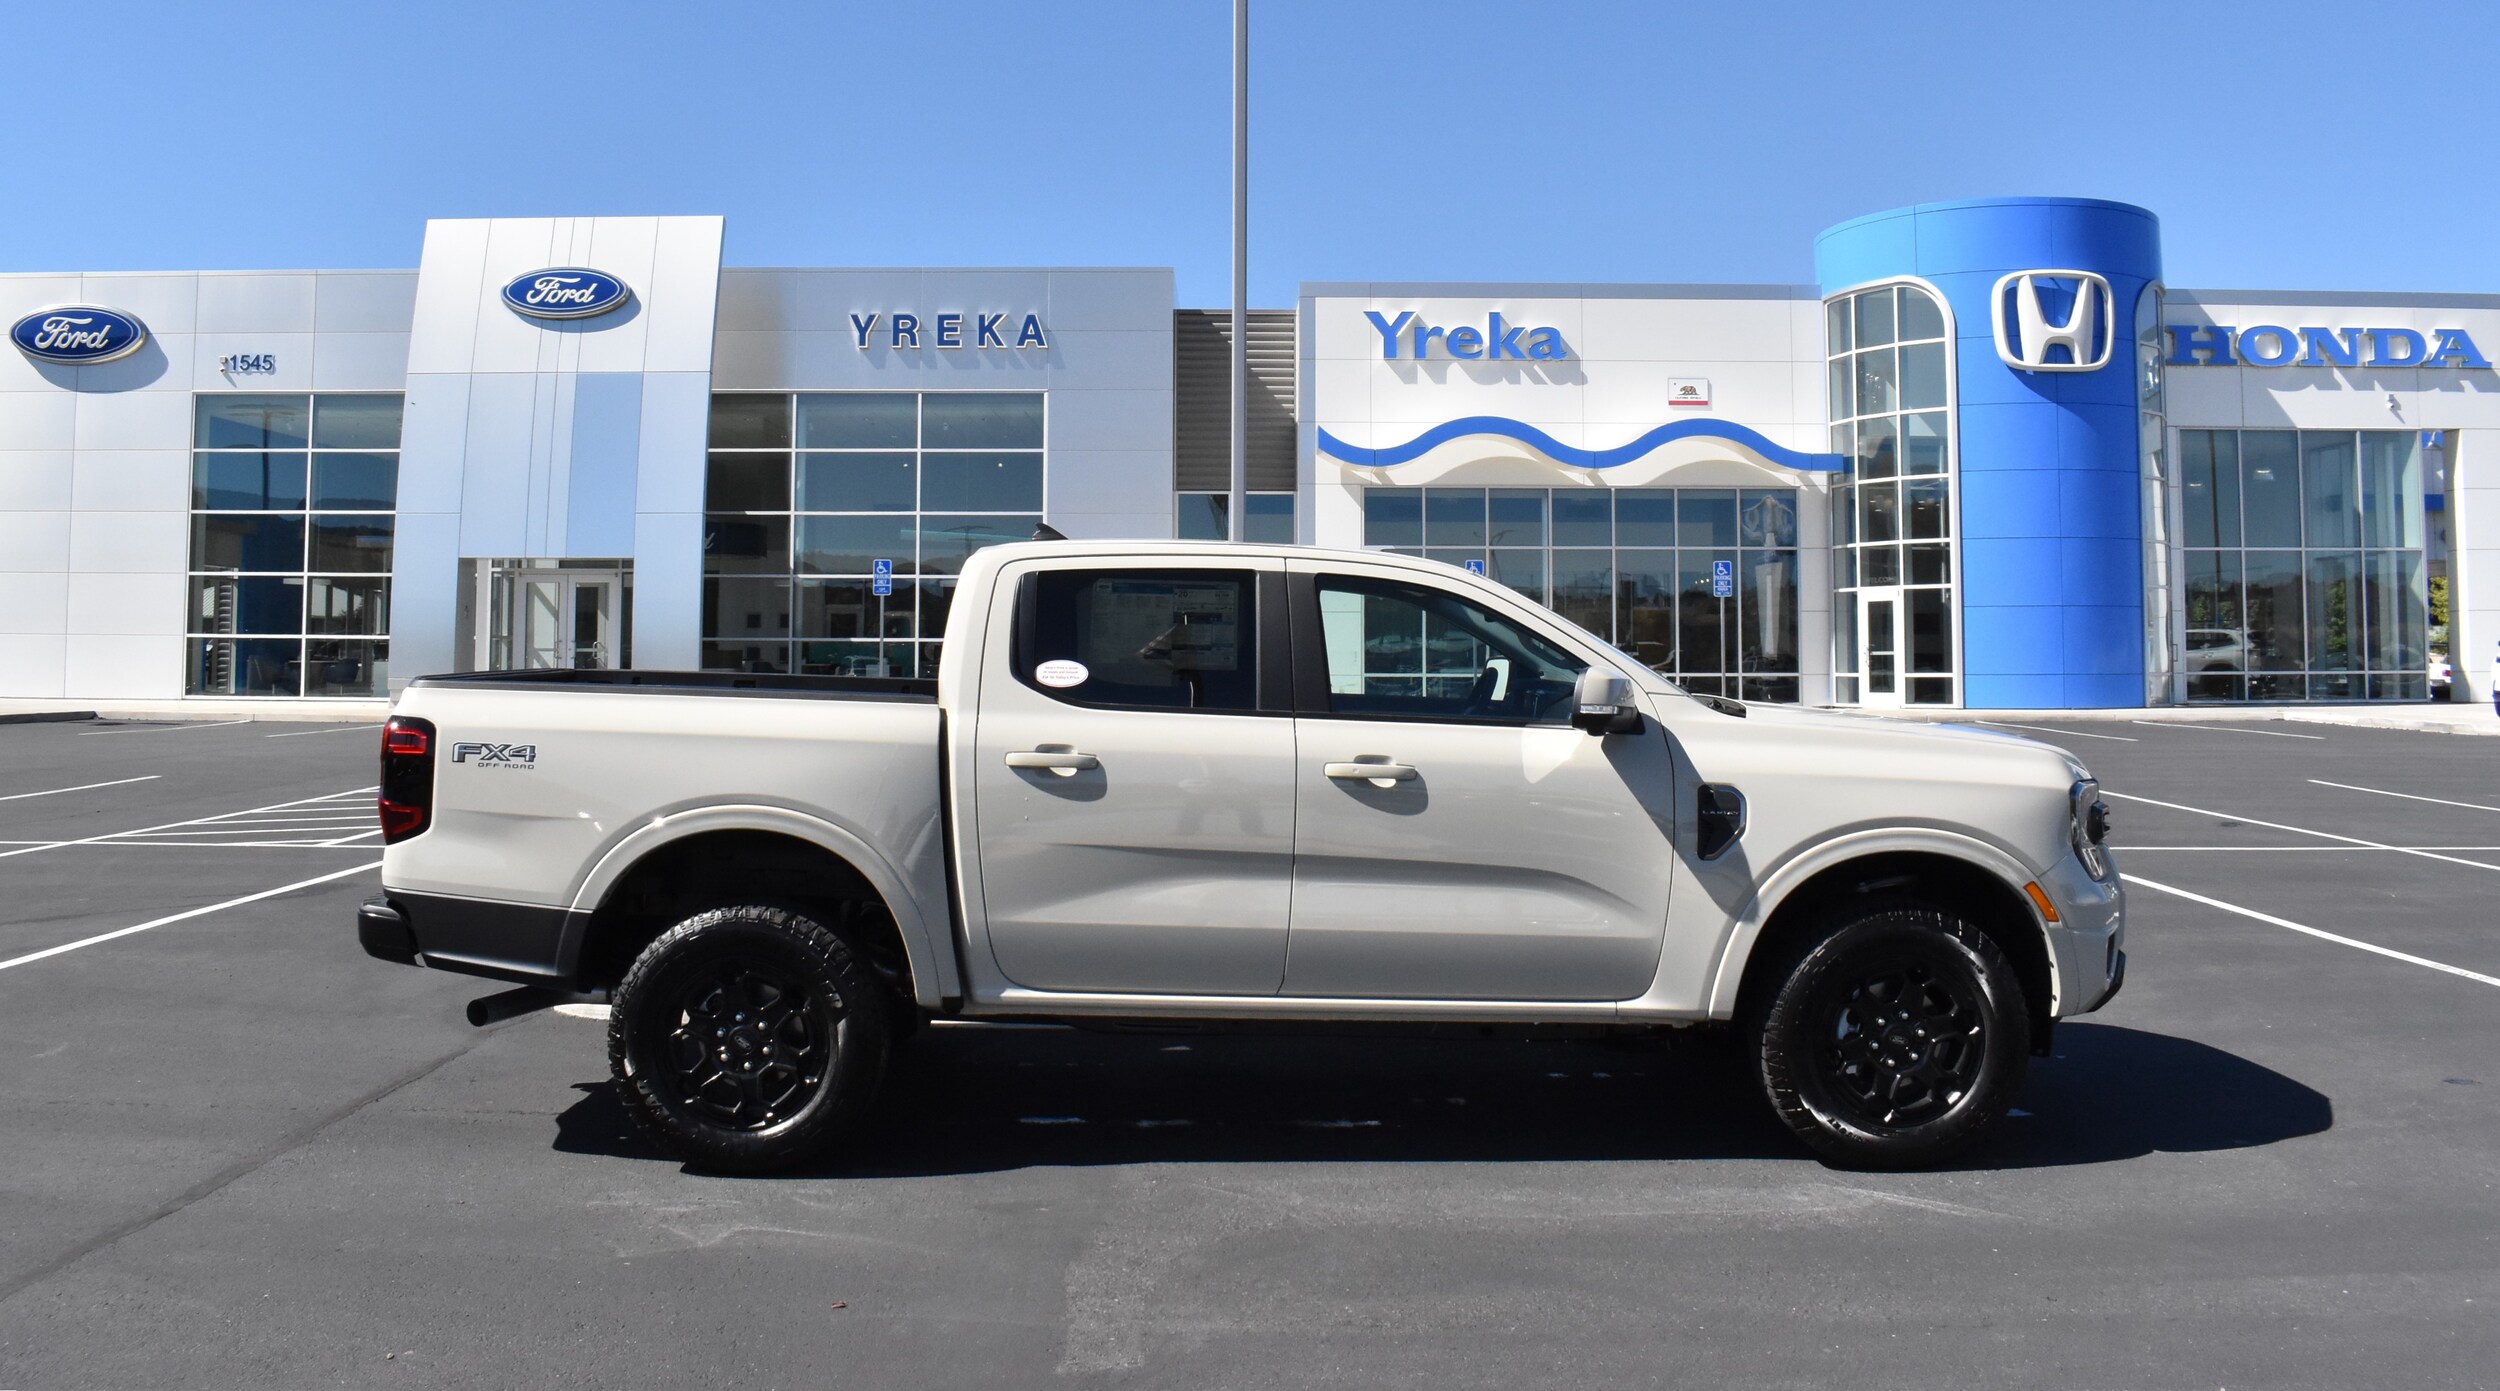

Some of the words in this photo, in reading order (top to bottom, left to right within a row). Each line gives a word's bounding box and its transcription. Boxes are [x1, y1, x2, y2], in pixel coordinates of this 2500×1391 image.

[526, 277, 598, 303] Ford
[34, 316, 111, 349] Ford
[849, 312, 1048, 349] YREKA
[1363, 311, 1568, 360] Yreka
[2165, 325, 2493, 367] HONDA
[229, 354, 273, 372] 1545
[452, 742, 536, 763] FX4
